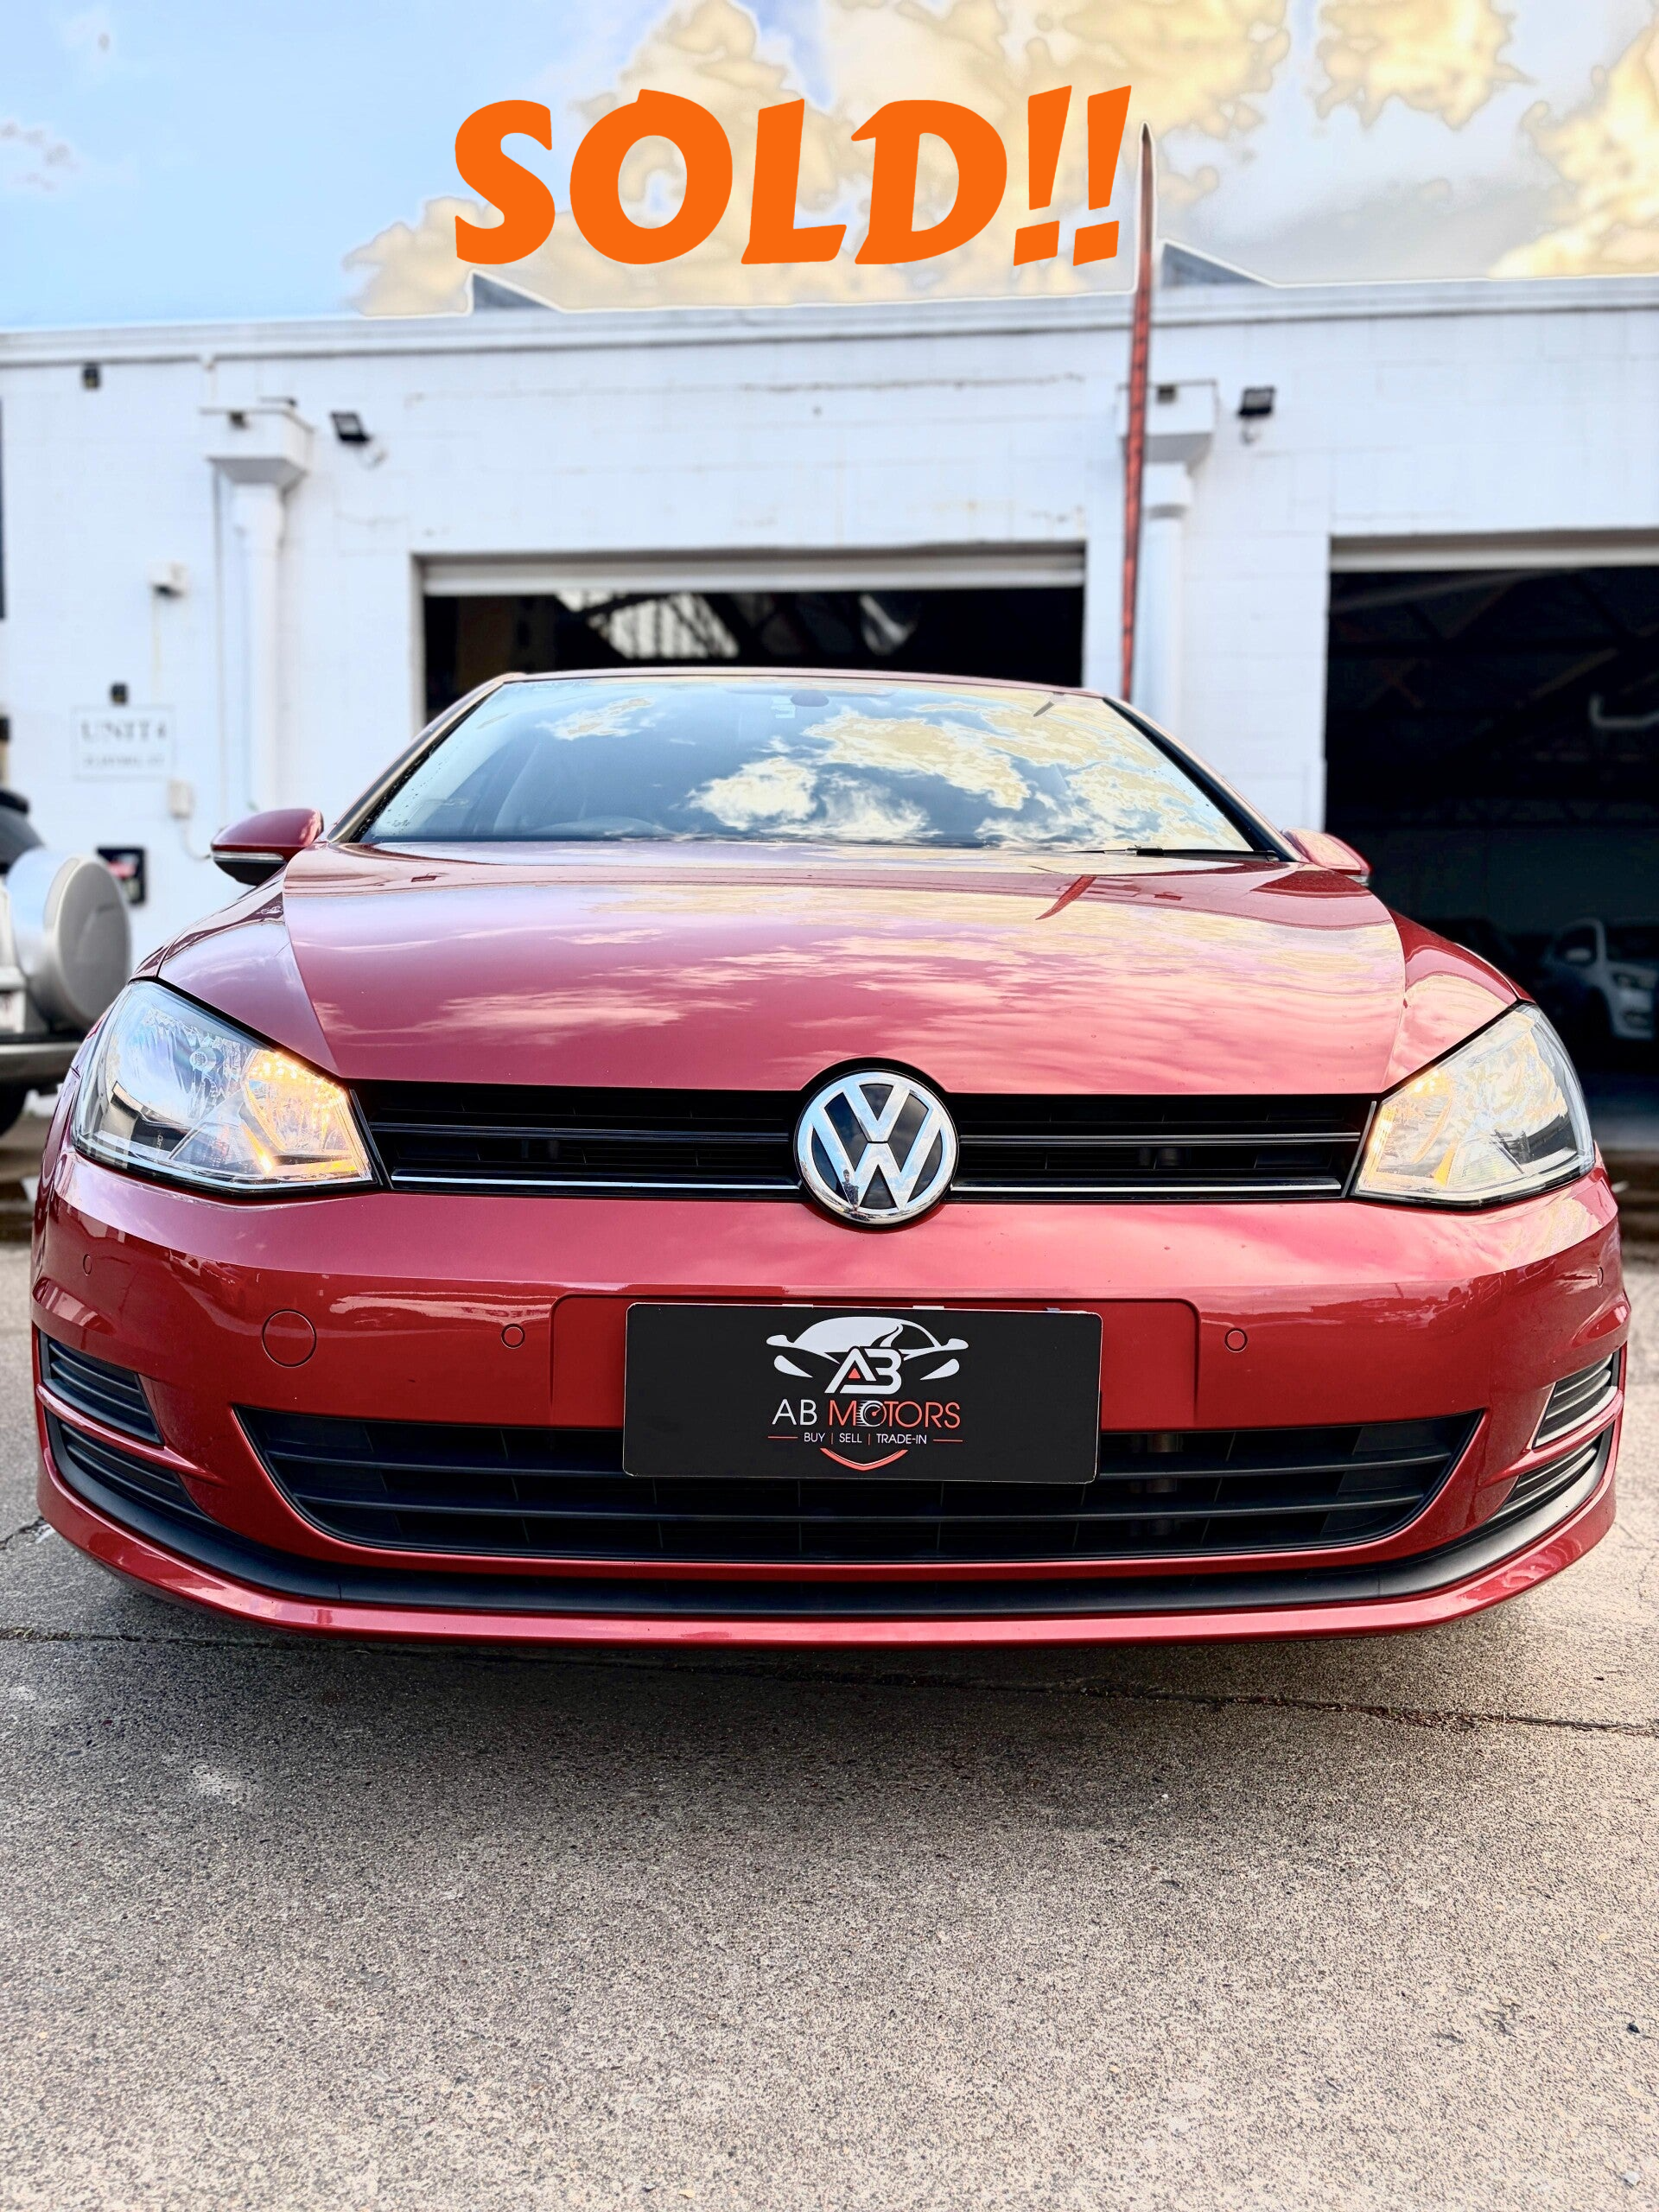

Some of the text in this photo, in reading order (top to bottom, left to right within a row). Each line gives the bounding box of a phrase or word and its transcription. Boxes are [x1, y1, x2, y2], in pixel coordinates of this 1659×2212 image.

[799, 1072, 956, 1222] VW
[823, 1347, 902, 1395] AB
[772, 1398, 961, 1428] AB MOTORS
[804, 1432, 927, 1445] BUY SELL TRADE-IN
